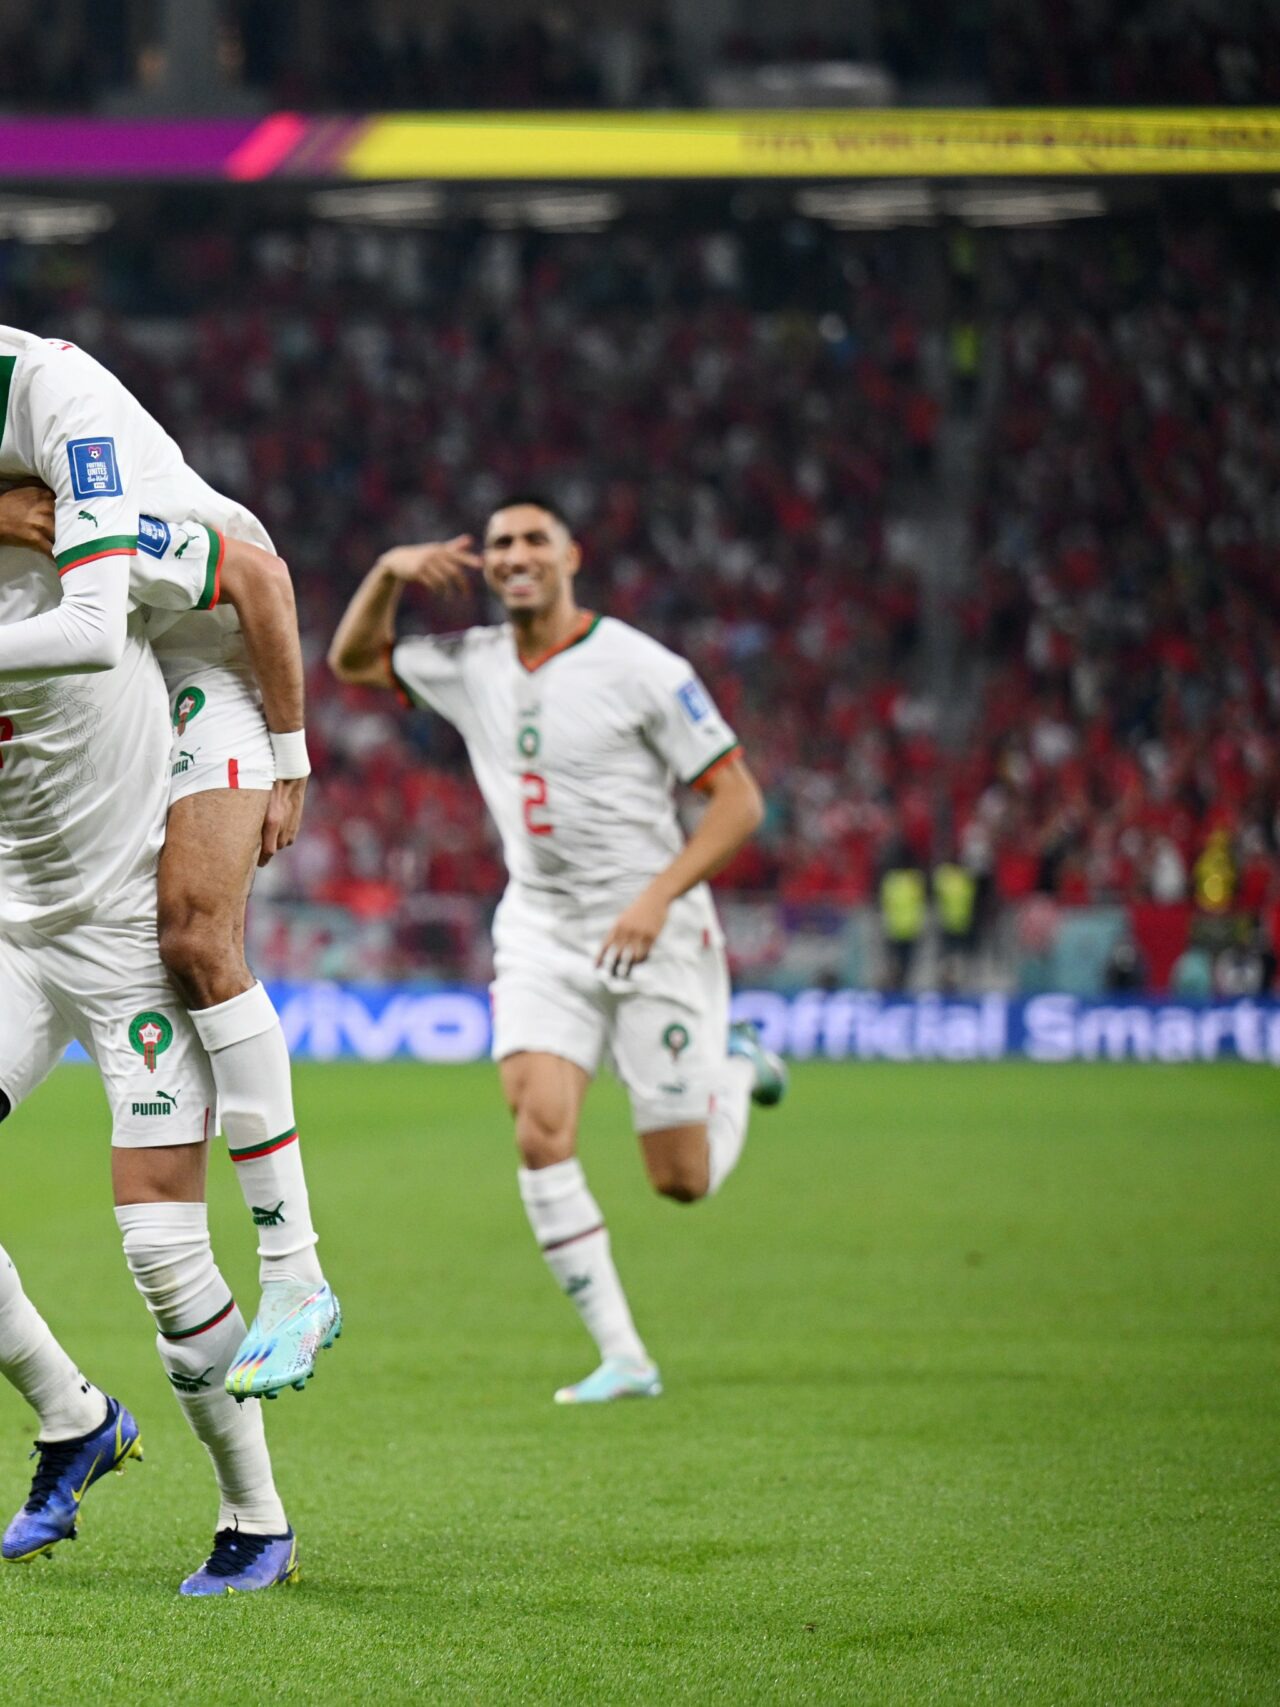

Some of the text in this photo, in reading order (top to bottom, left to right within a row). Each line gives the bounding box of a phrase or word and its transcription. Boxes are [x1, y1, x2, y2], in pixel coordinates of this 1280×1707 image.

[521, 773, 554, 836] 2
[730, 988, 1008, 1060] Official
[132, 1102, 171, 1115] PUMA
